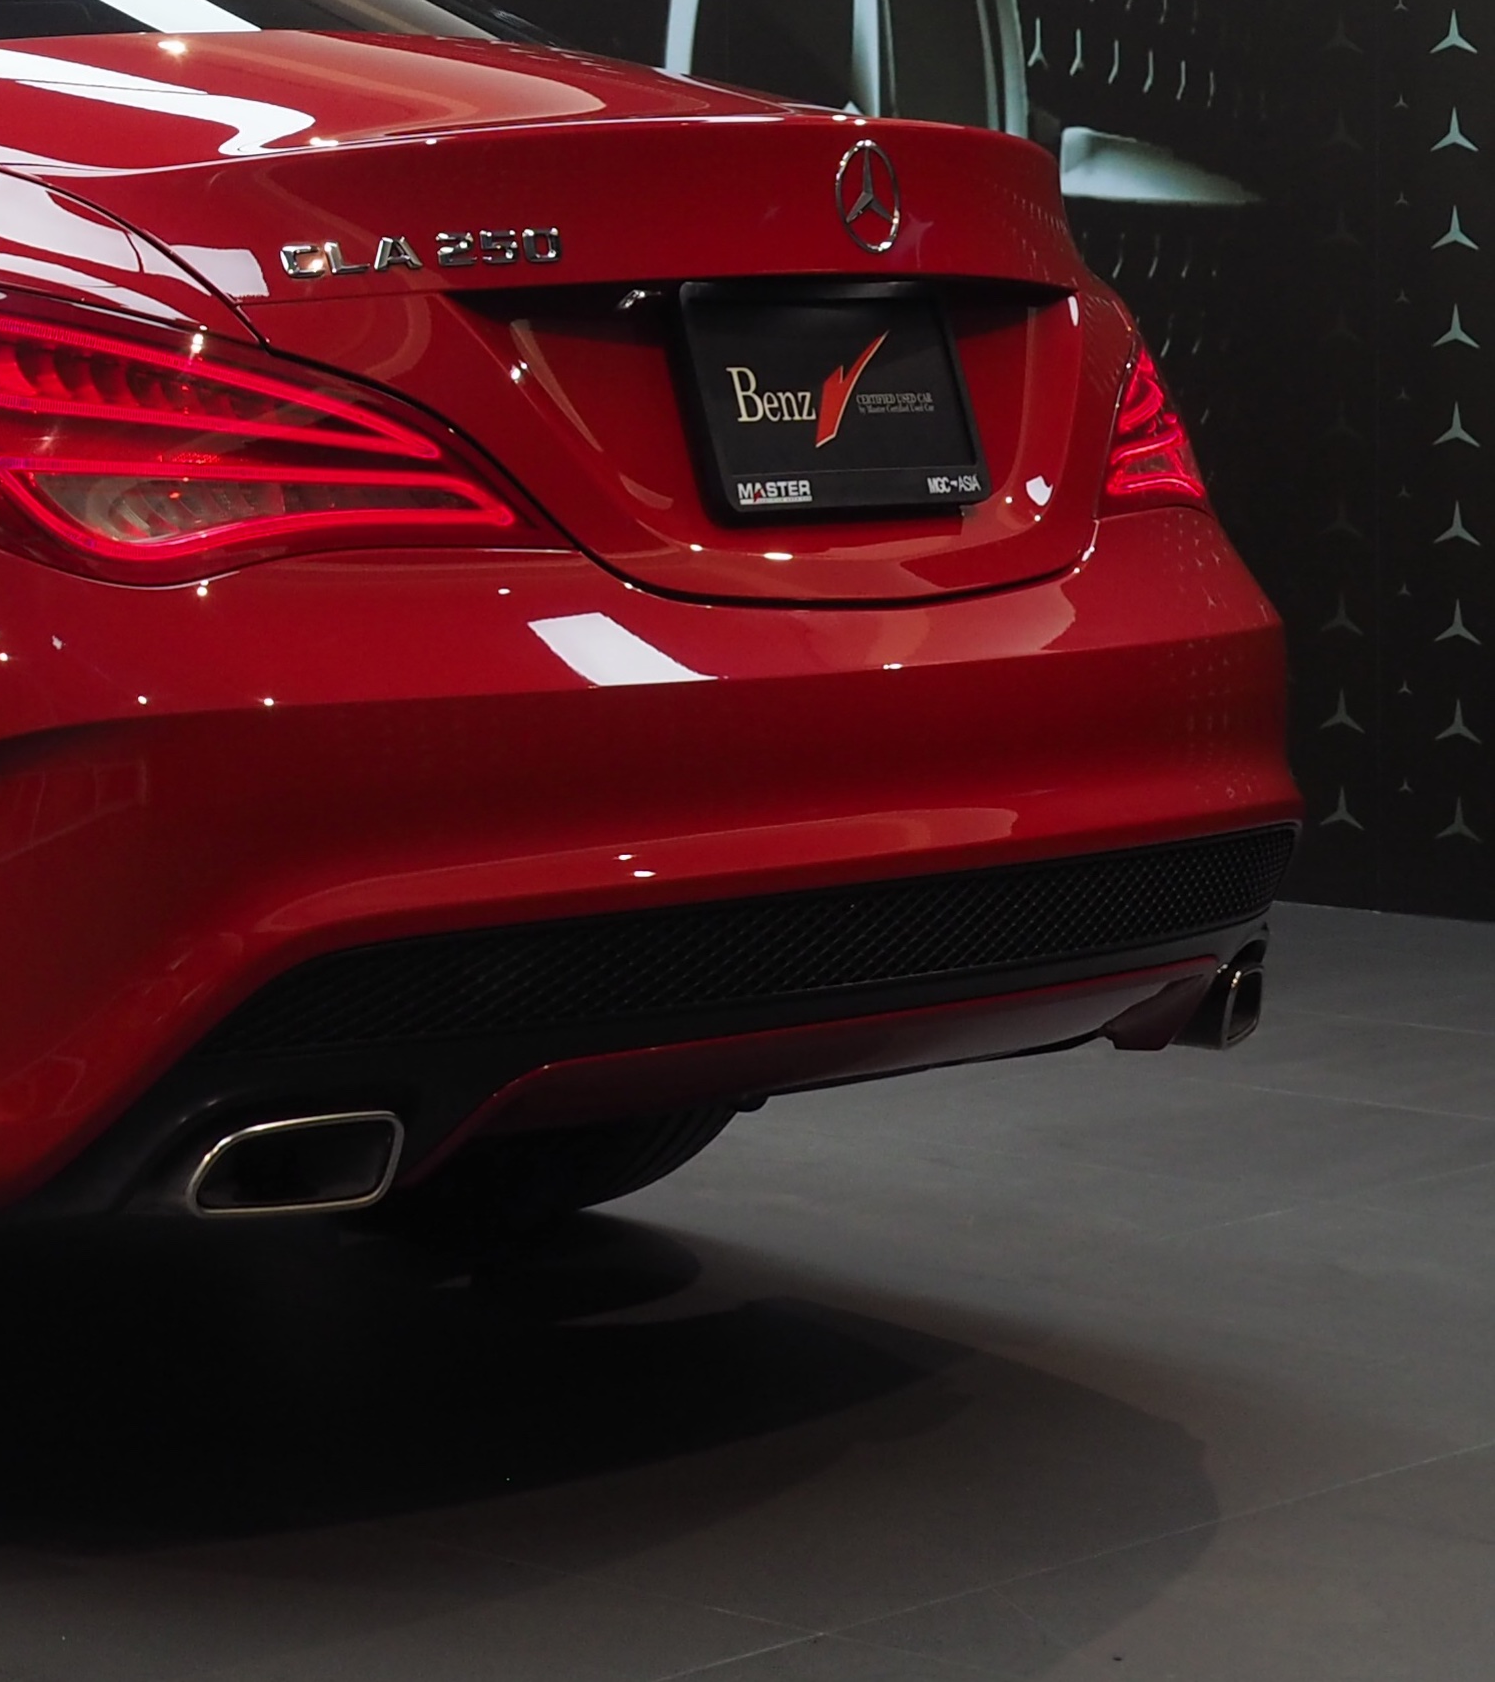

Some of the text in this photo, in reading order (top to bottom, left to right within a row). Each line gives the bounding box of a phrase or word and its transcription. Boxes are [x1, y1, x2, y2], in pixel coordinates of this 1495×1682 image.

[279, 227, 561, 279] CLA 250
[726, 366, 817, 422] Benz
[855, 393, 896, 405] CERTIFIED
[917, 391, 933, 403] CAR
[737, 480, 811, 499] MASTER
